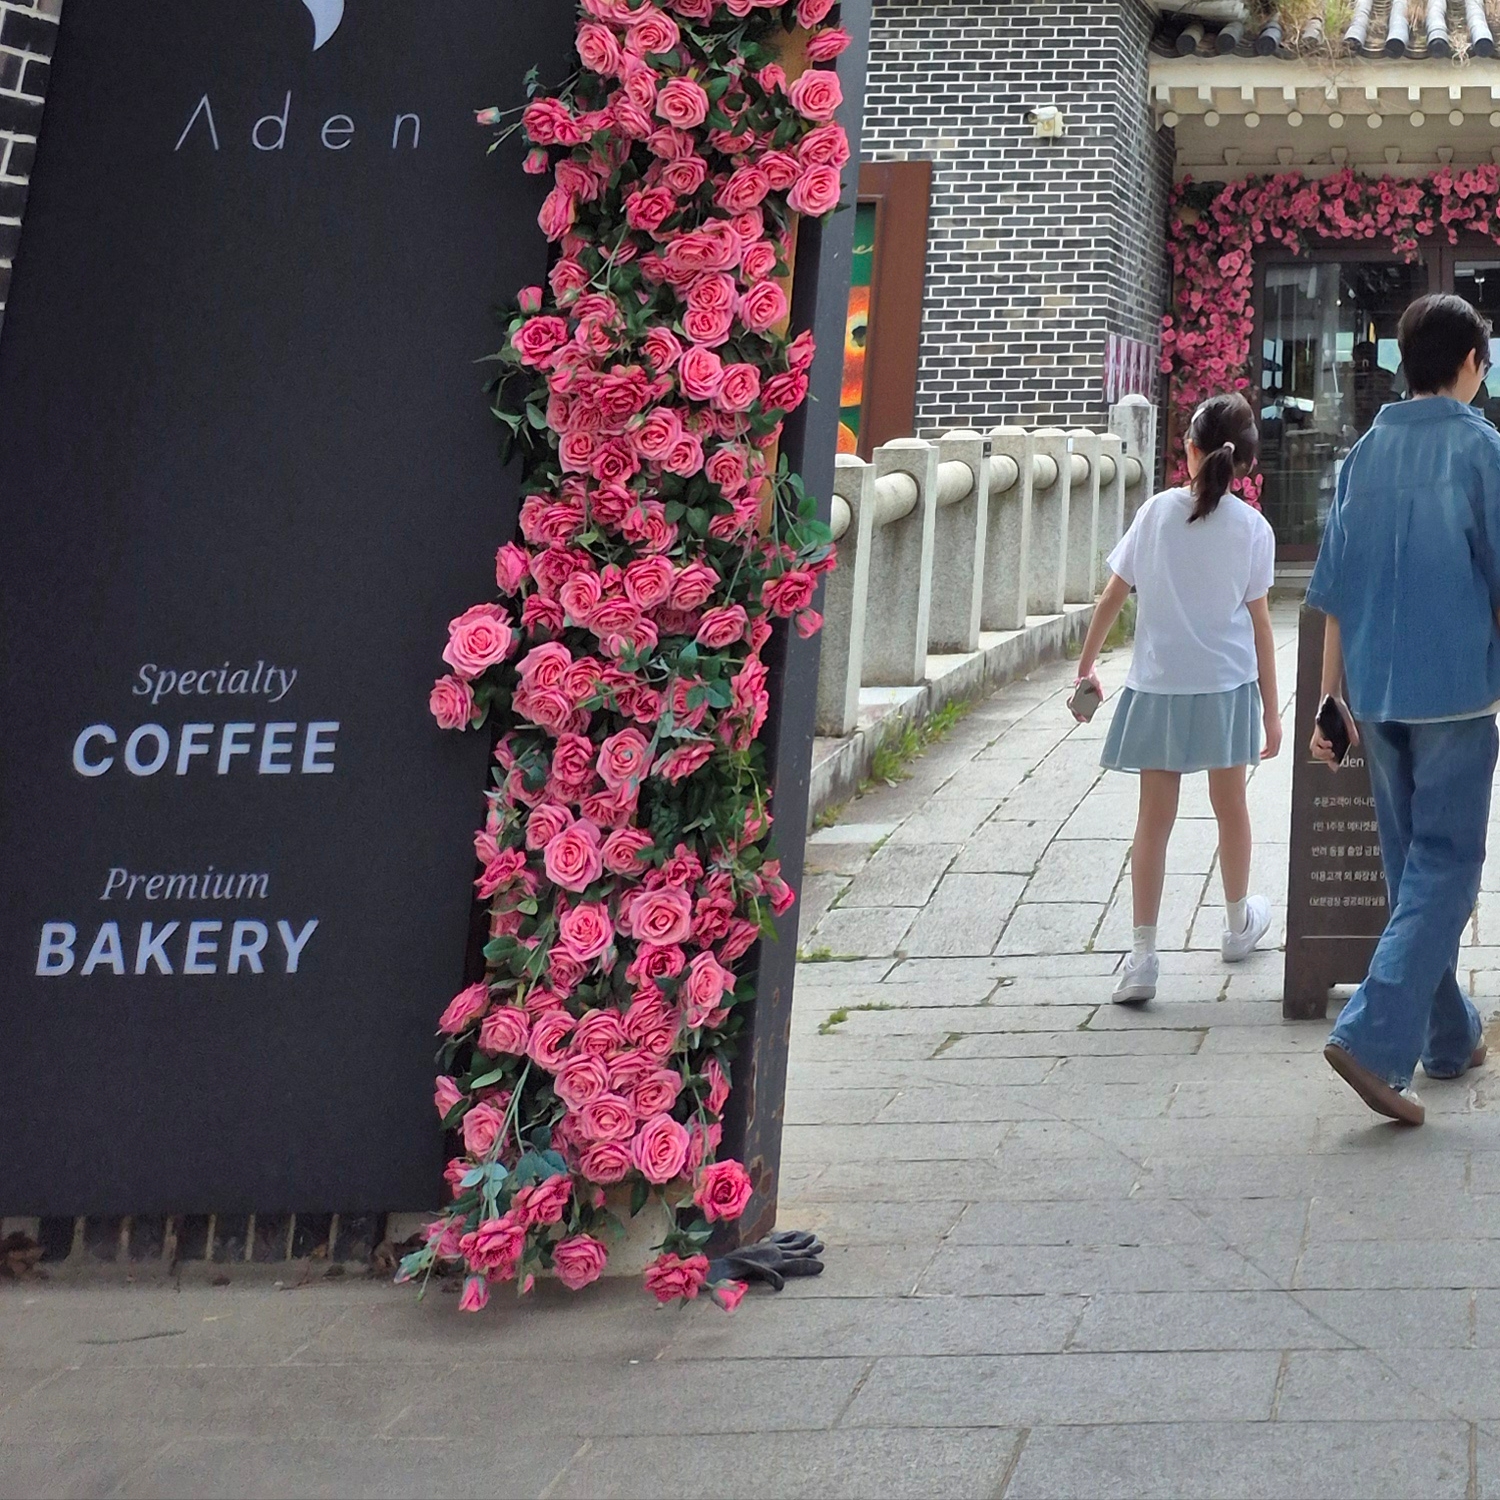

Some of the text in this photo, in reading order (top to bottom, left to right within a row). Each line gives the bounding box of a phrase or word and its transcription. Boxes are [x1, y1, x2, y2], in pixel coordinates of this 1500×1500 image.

[175, 90, 420, 150] Aden
[133, 661, 297, 704] Specialty
[73, 722, 339, 776] COFFEE
[1341, 754, 1364, 768] den
[100, 866, 268, 900] Premium
[36, 920, 318, 976] BAKERY
